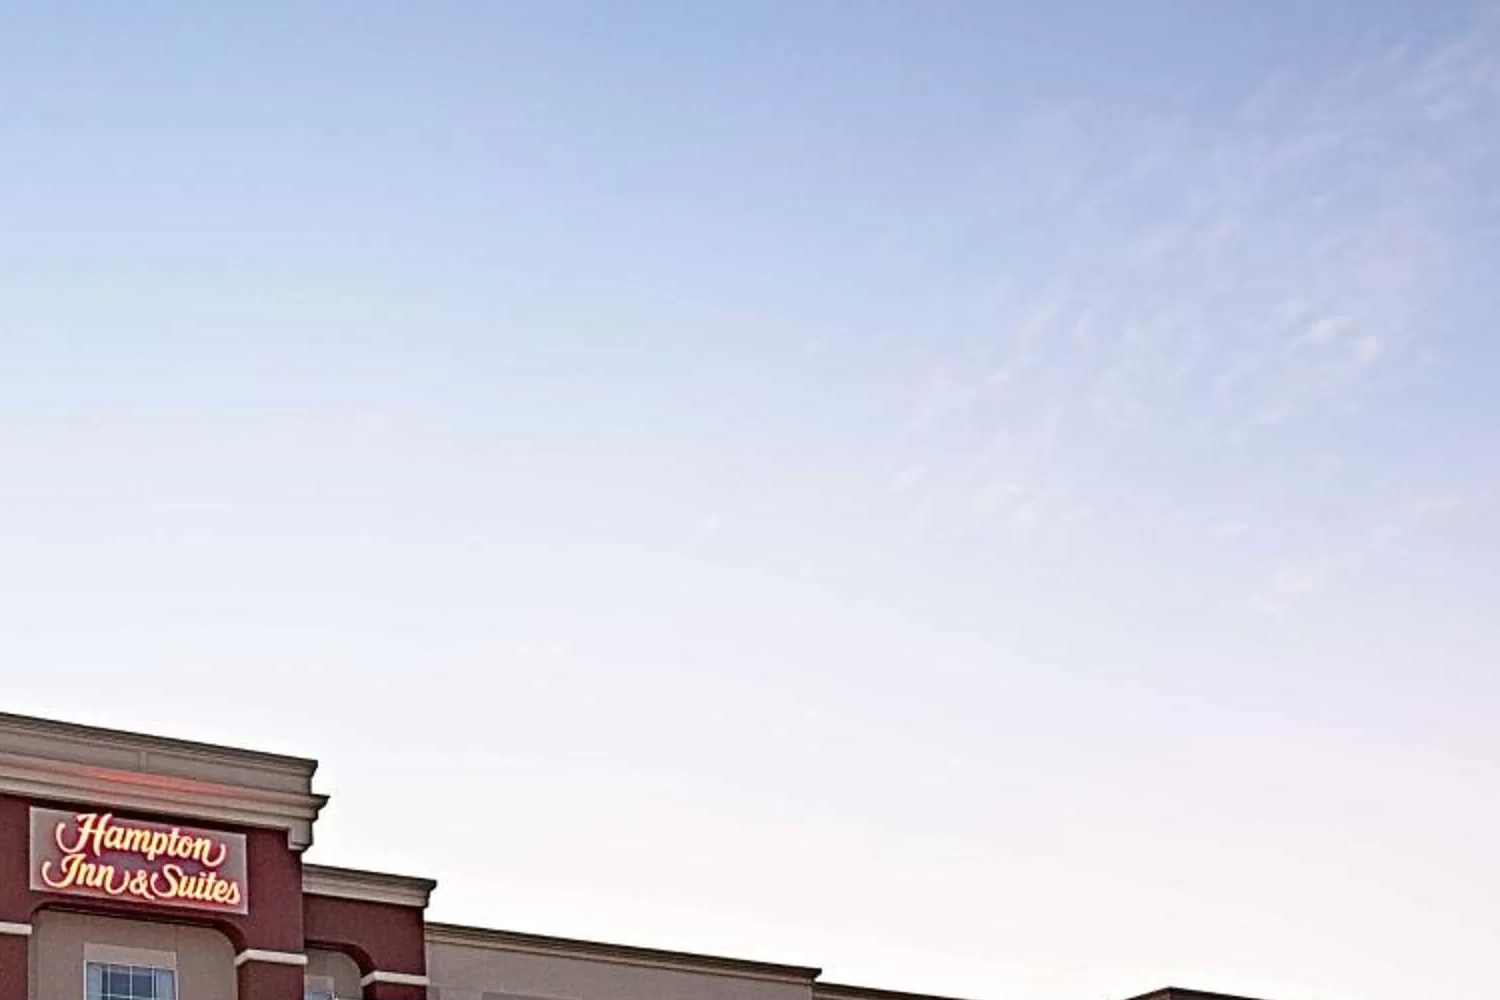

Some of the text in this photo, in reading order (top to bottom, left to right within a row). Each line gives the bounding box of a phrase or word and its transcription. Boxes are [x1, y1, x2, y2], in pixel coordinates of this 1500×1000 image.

[56, 813, 226, 867] Hampton
[41, 853, 241, 905] Inn & Suites
